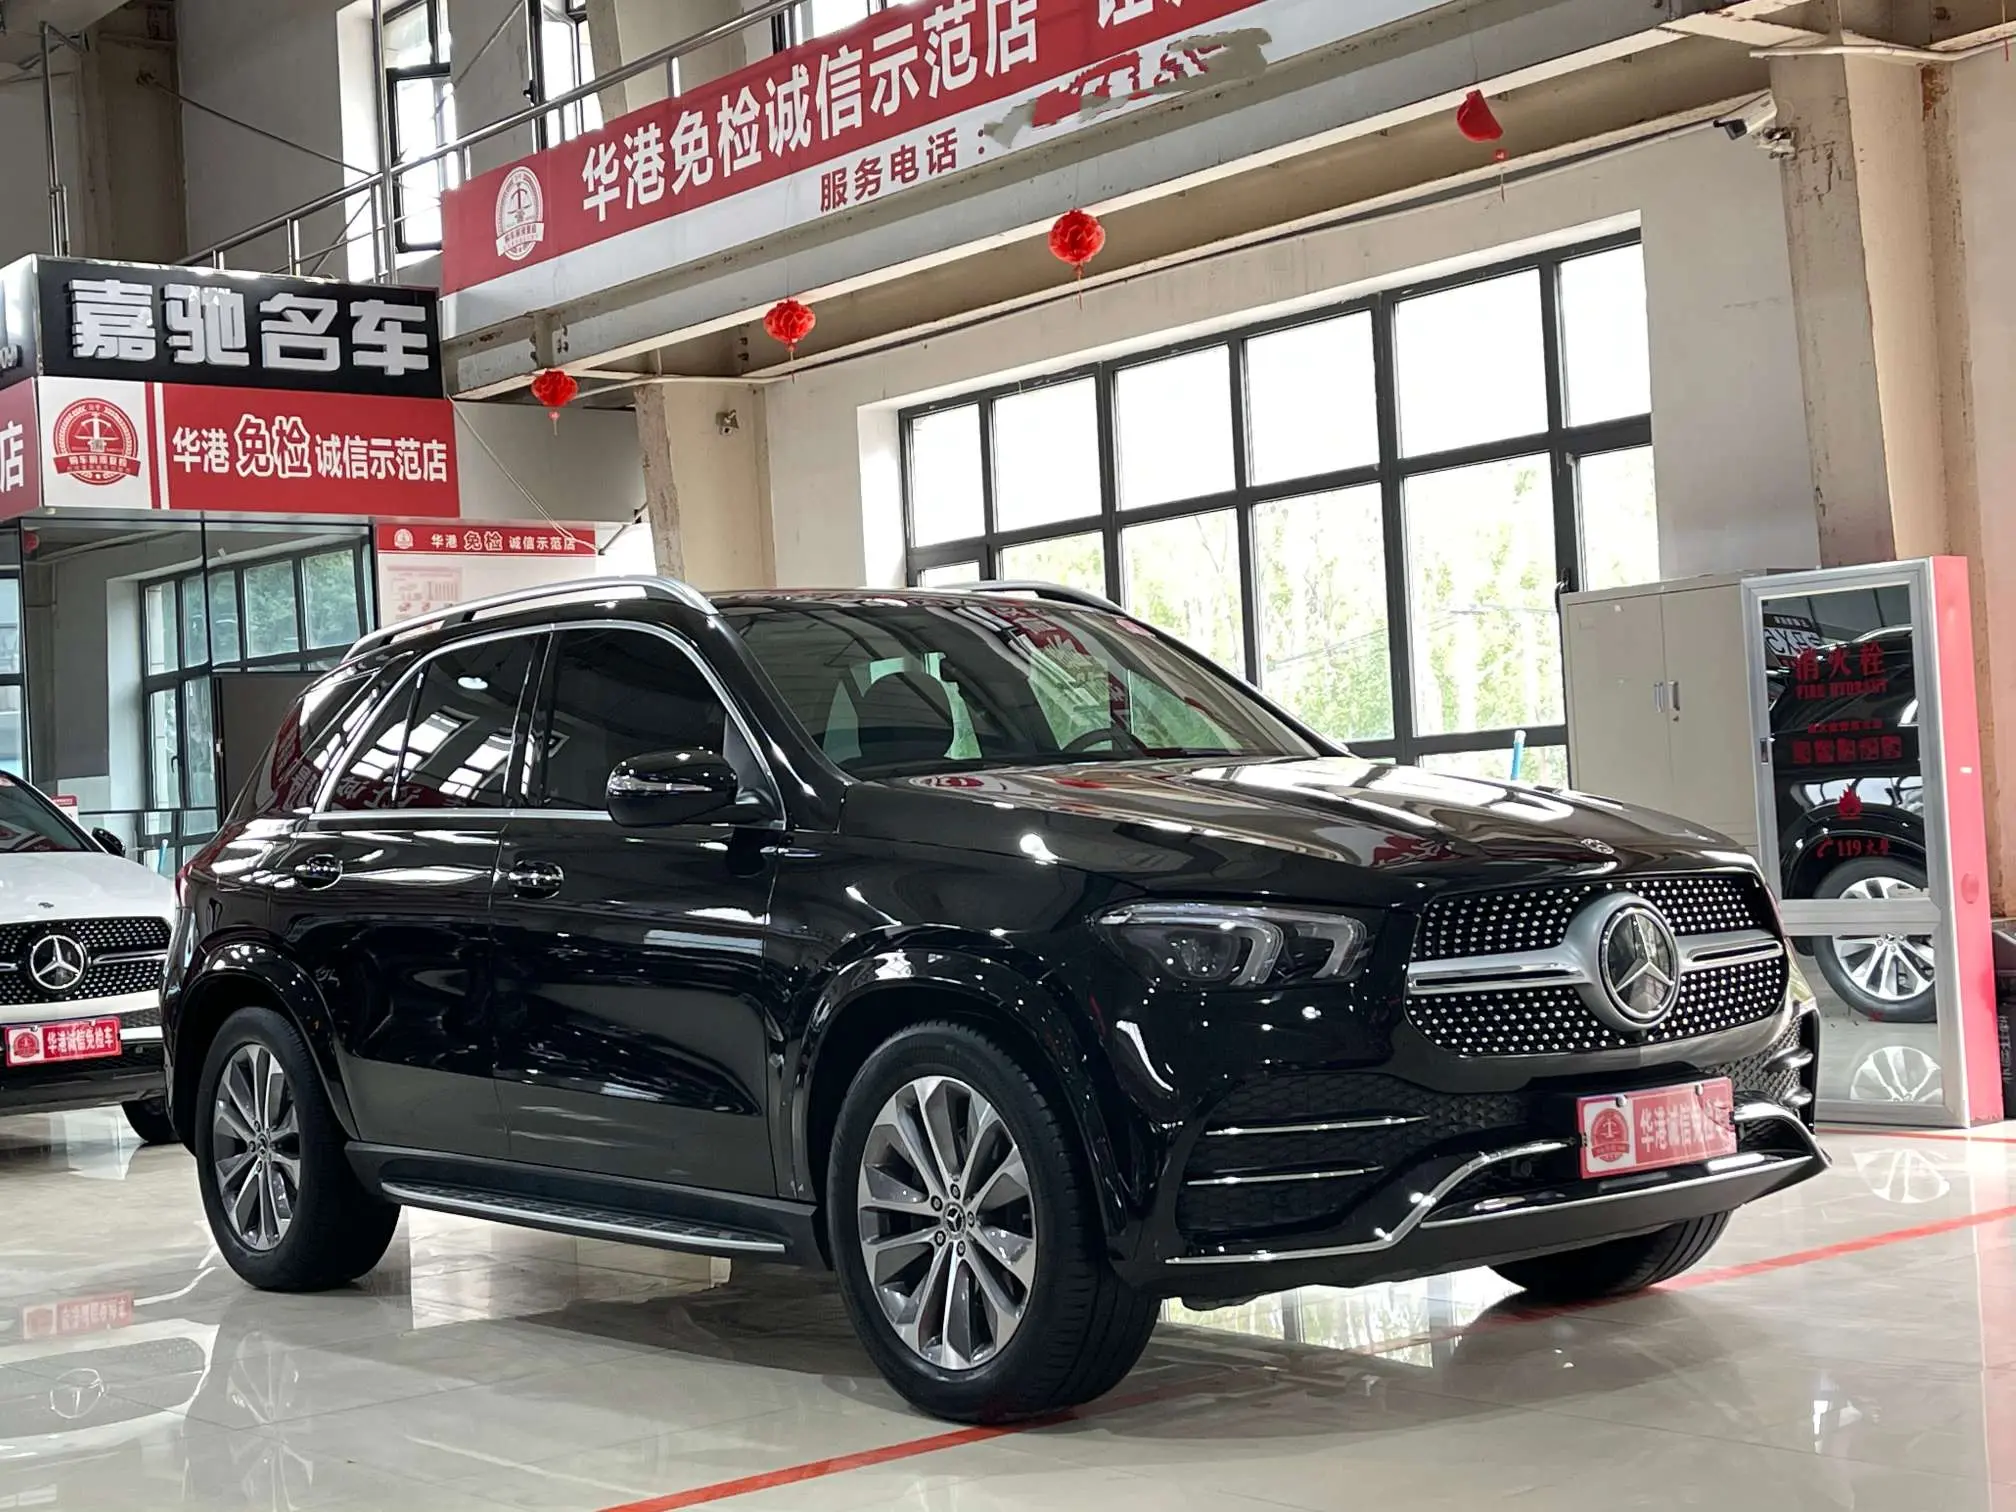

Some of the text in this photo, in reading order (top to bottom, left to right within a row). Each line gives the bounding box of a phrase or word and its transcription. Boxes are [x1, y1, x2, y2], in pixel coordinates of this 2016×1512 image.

[582, 0, 1037, 222] 华港免检诚信示范店
[70, 279, 430, 376] 嘉驰名车
[172, 413, 448, 482] 华港免检诚信示范店
[1795, 639, 1885, 681] 消火栓
